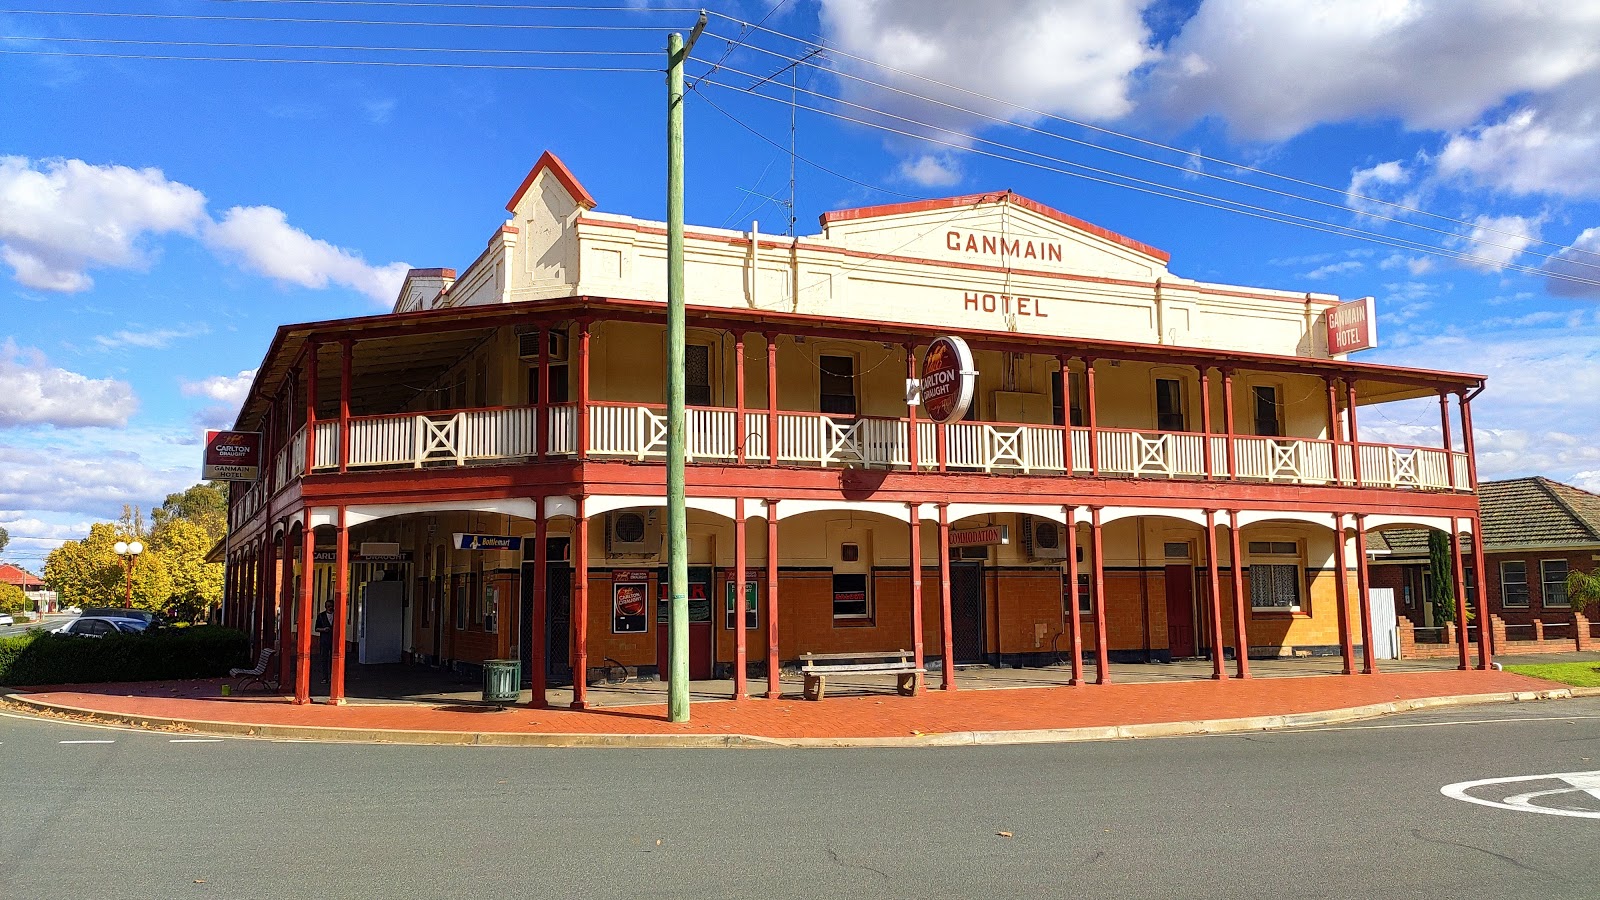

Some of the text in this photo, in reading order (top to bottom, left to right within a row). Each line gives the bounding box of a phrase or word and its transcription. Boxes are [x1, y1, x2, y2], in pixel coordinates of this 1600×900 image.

[946, 231, 1061, 262] GANMAIN
[964, 292, 1048, 317] HOTEL
[1329, 305, 1365, 329] GANMAIN
[1336, 327, 1361, 348] HOTEL
[924, 384, 950, 400] DRAUGHT
[215, 445, 250, 453] CARLTON
[949, 528, 998, 545] COMMODATION
